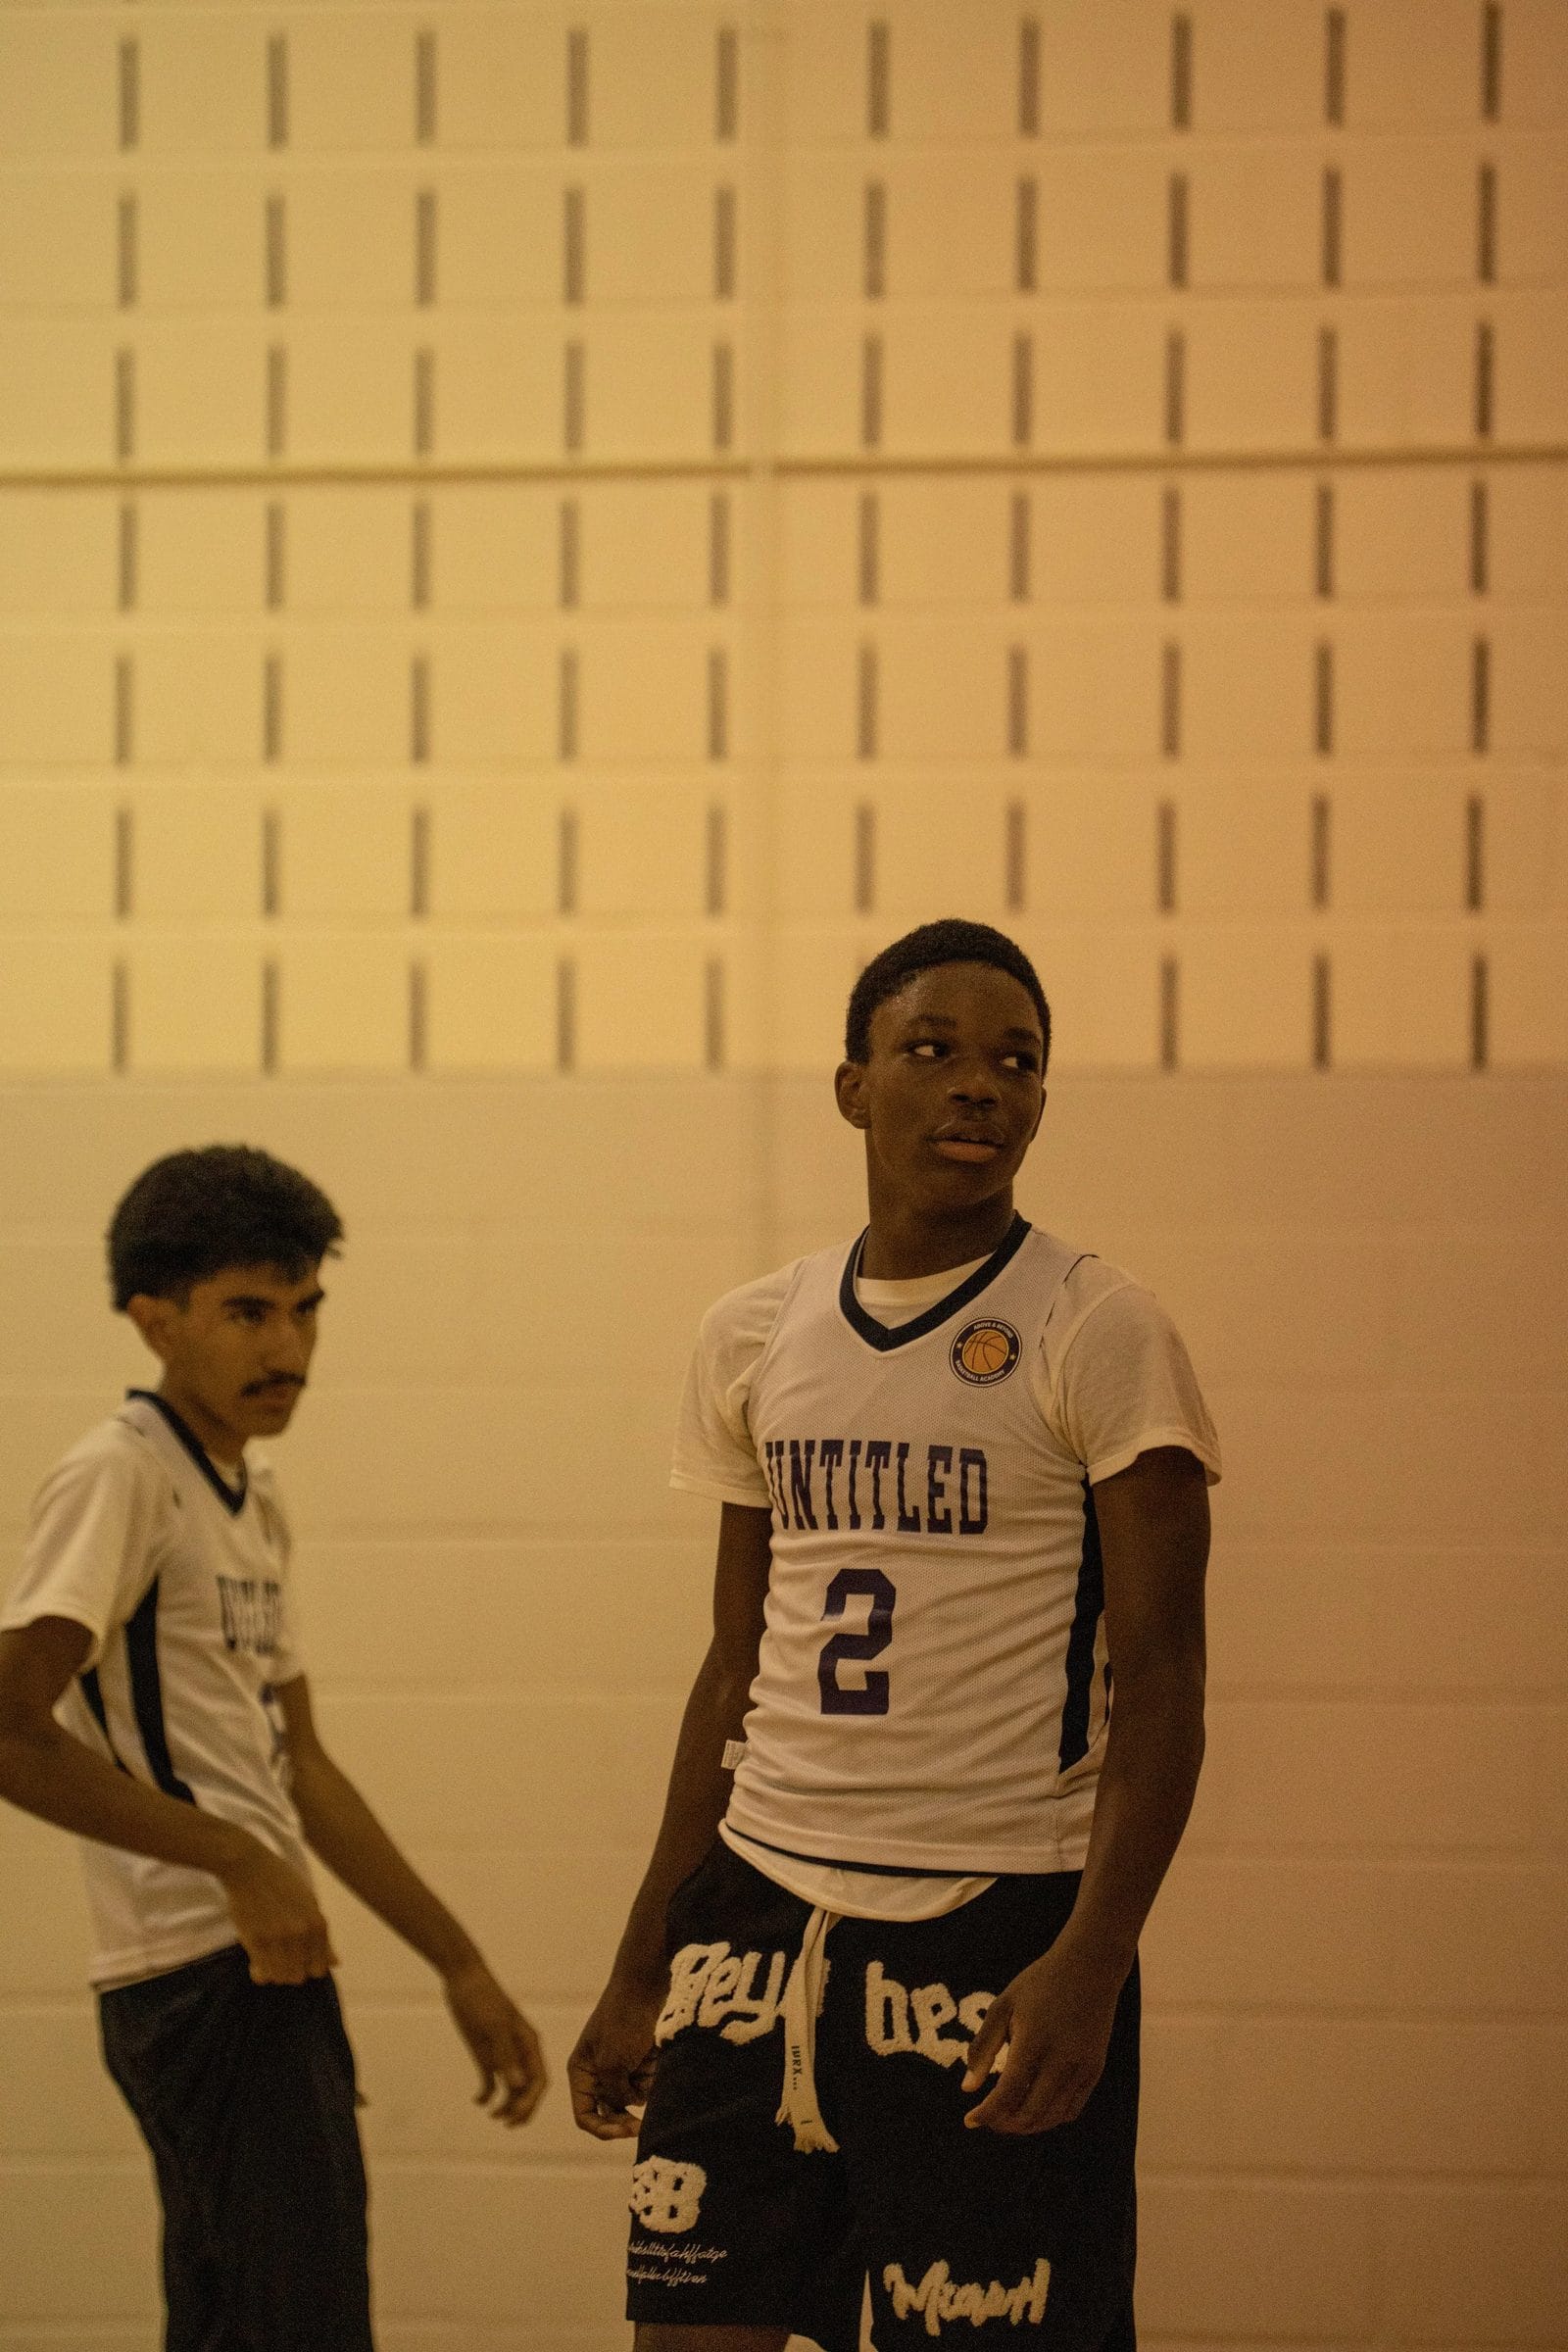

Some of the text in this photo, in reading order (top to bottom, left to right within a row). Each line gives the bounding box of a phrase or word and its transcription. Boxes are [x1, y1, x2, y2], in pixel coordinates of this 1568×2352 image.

[973, 1322, 991, 1331] ABOVE
[956, 1360, 1004, 1382] BASKETBALL ACADEMY
[765, 1440, 987, 1535] UNTITLED
[817, 1568, 896, 1715] 2
